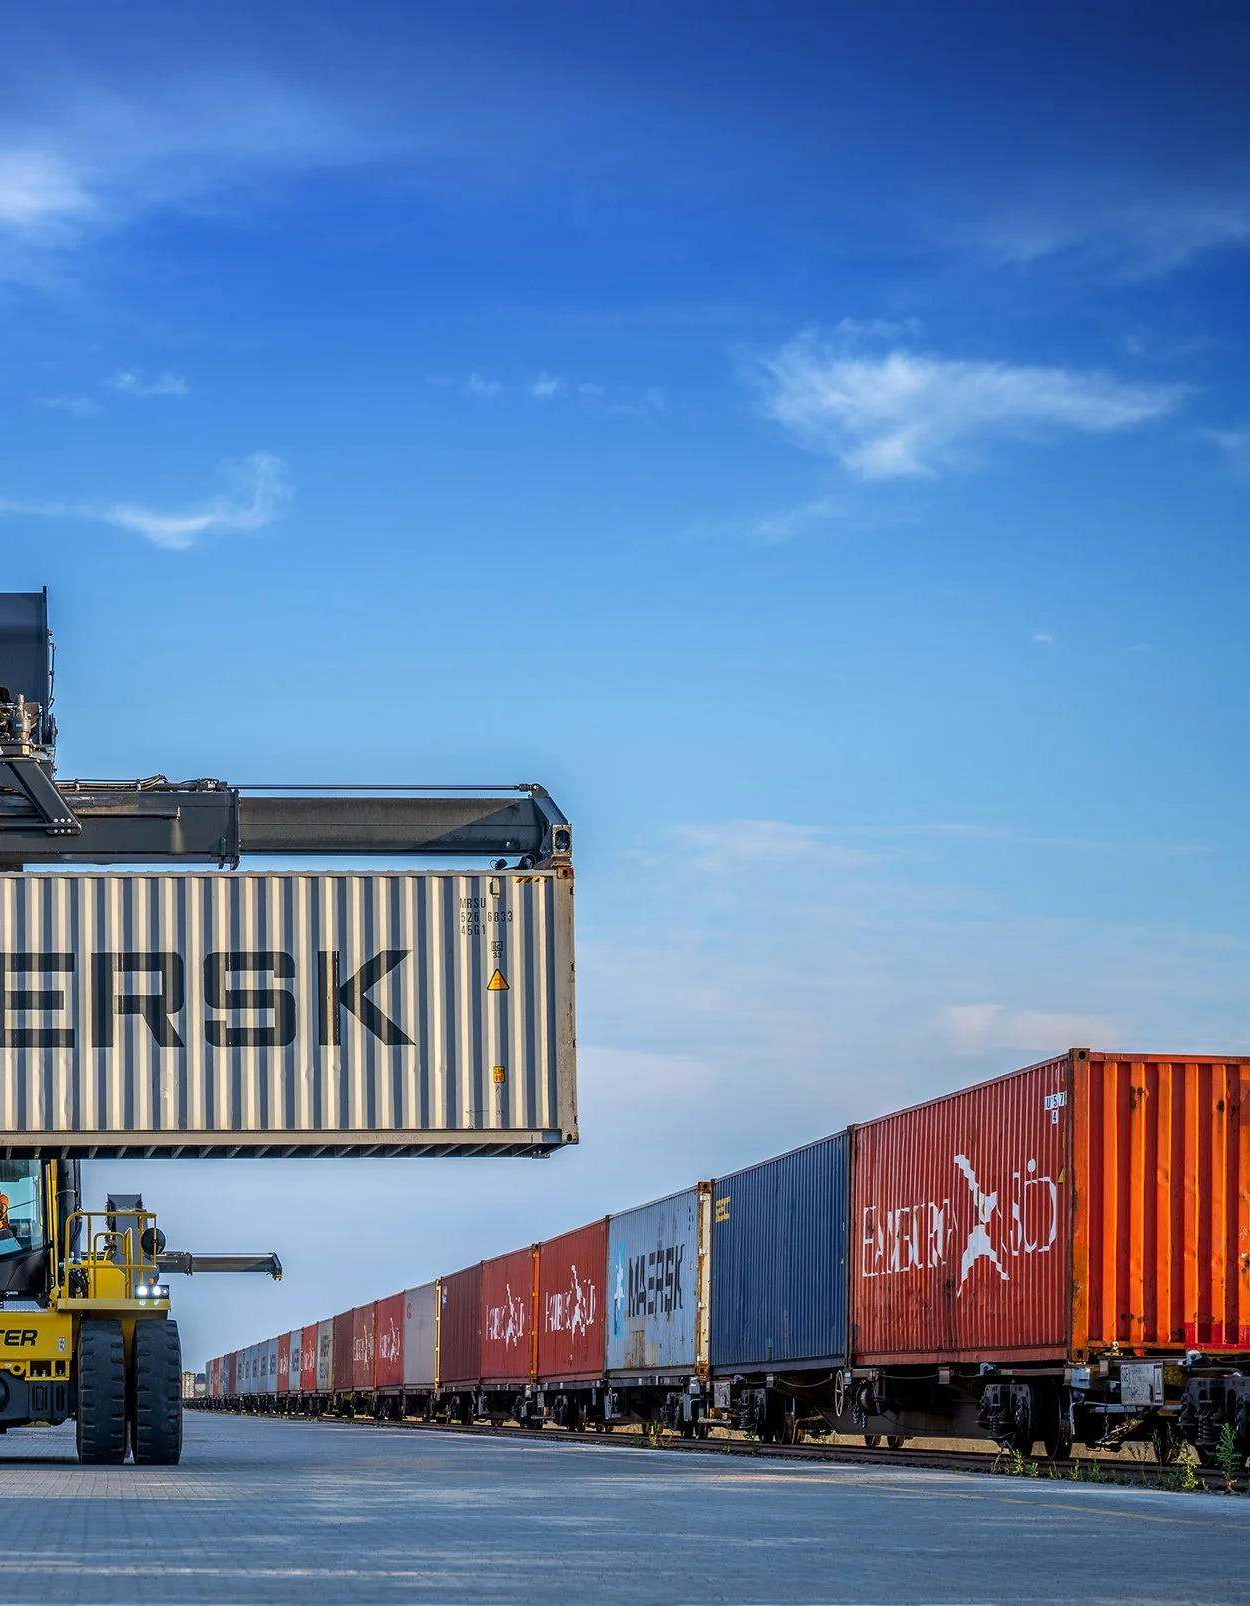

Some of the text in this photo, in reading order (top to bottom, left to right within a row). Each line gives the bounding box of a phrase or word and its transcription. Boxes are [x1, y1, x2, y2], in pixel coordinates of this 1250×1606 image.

[459, 898, 486, 909] MRSU
[460, 910, 513, 922] 526 6833
[461, 924, 486, 936] 45G1
[628, 1244, 685, 1318] MAERSK
